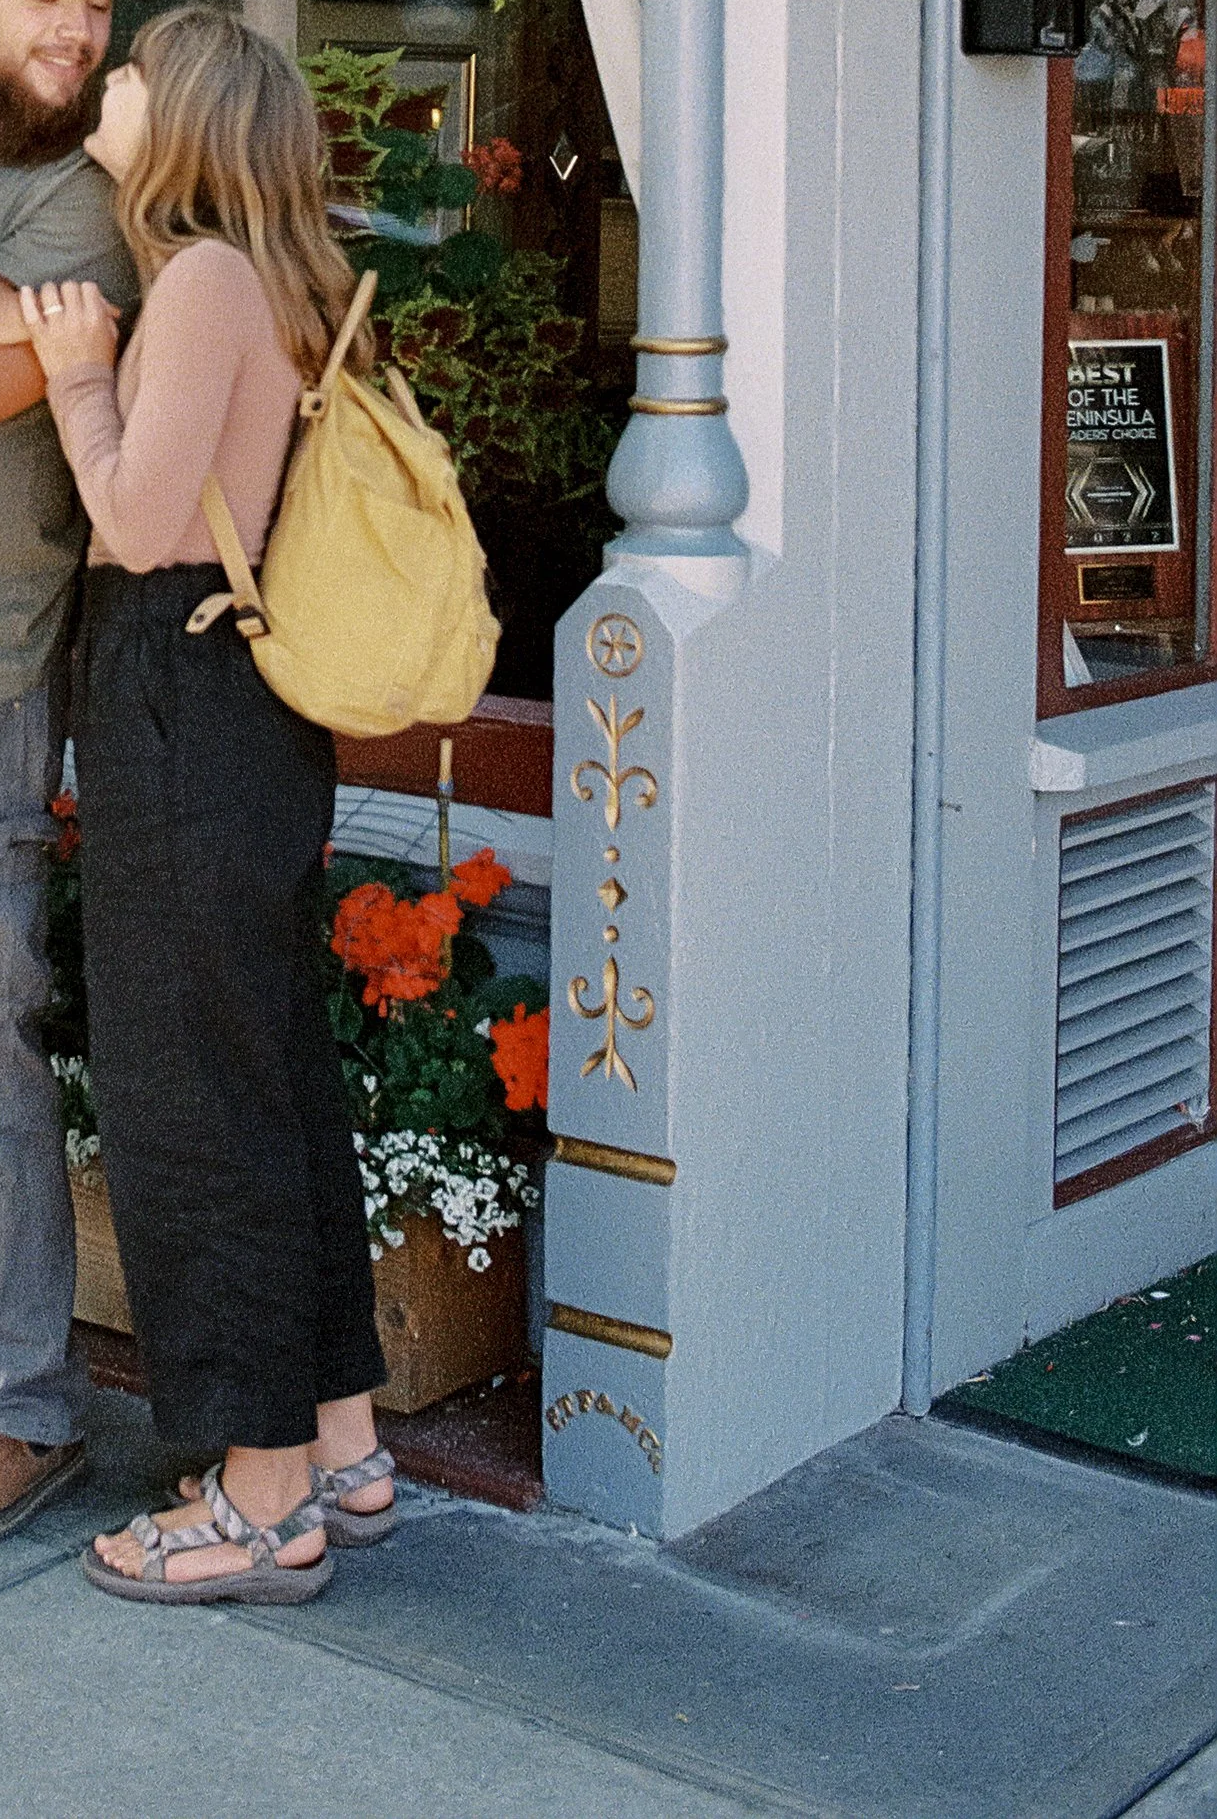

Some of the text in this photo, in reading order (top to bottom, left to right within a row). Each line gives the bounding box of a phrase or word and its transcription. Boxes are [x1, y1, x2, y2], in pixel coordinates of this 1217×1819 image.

[1067, 363, 1136, 384] BEST
[1068, 388, 1140, 407] OF THE
[1111, 427, 1157, 440] CHOICE
